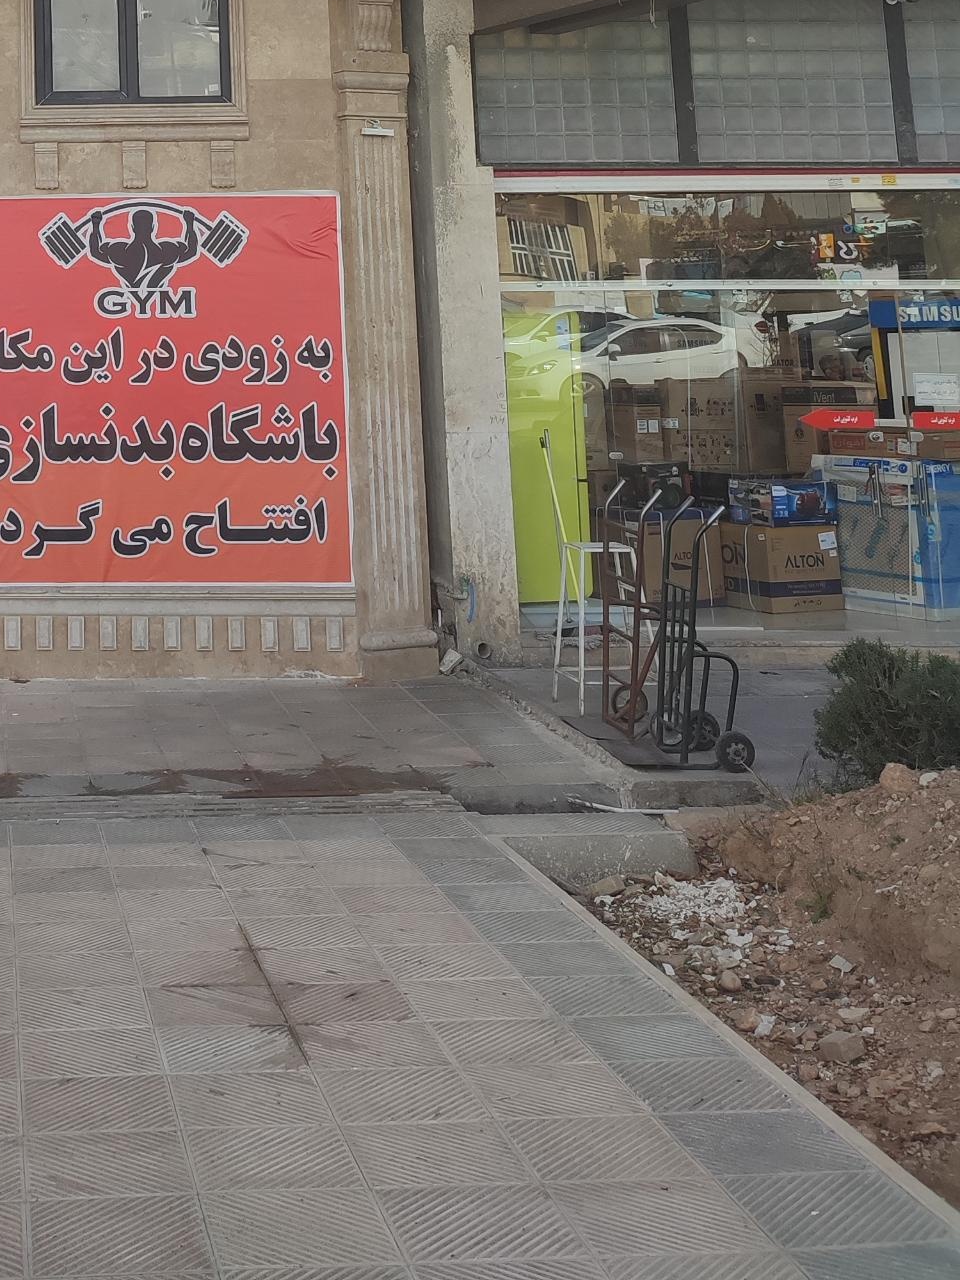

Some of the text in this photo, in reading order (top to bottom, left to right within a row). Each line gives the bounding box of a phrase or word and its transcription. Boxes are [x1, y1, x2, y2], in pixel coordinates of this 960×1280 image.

[95, 289, 195, 317] GYM
[62, 327, 123, 385] این
[130, 337, 176, 385] در
[184, 335, 289, 384] زودی
[296, 336, 332, 382] به
[179, 403, 339, 479] باشگاه
[111, 516, 173, 557] می
[183, 496, 327, 556] افتتاح
[674, 551, 693, 561] ALTO
[784, 551, 826, 569] ALTON
